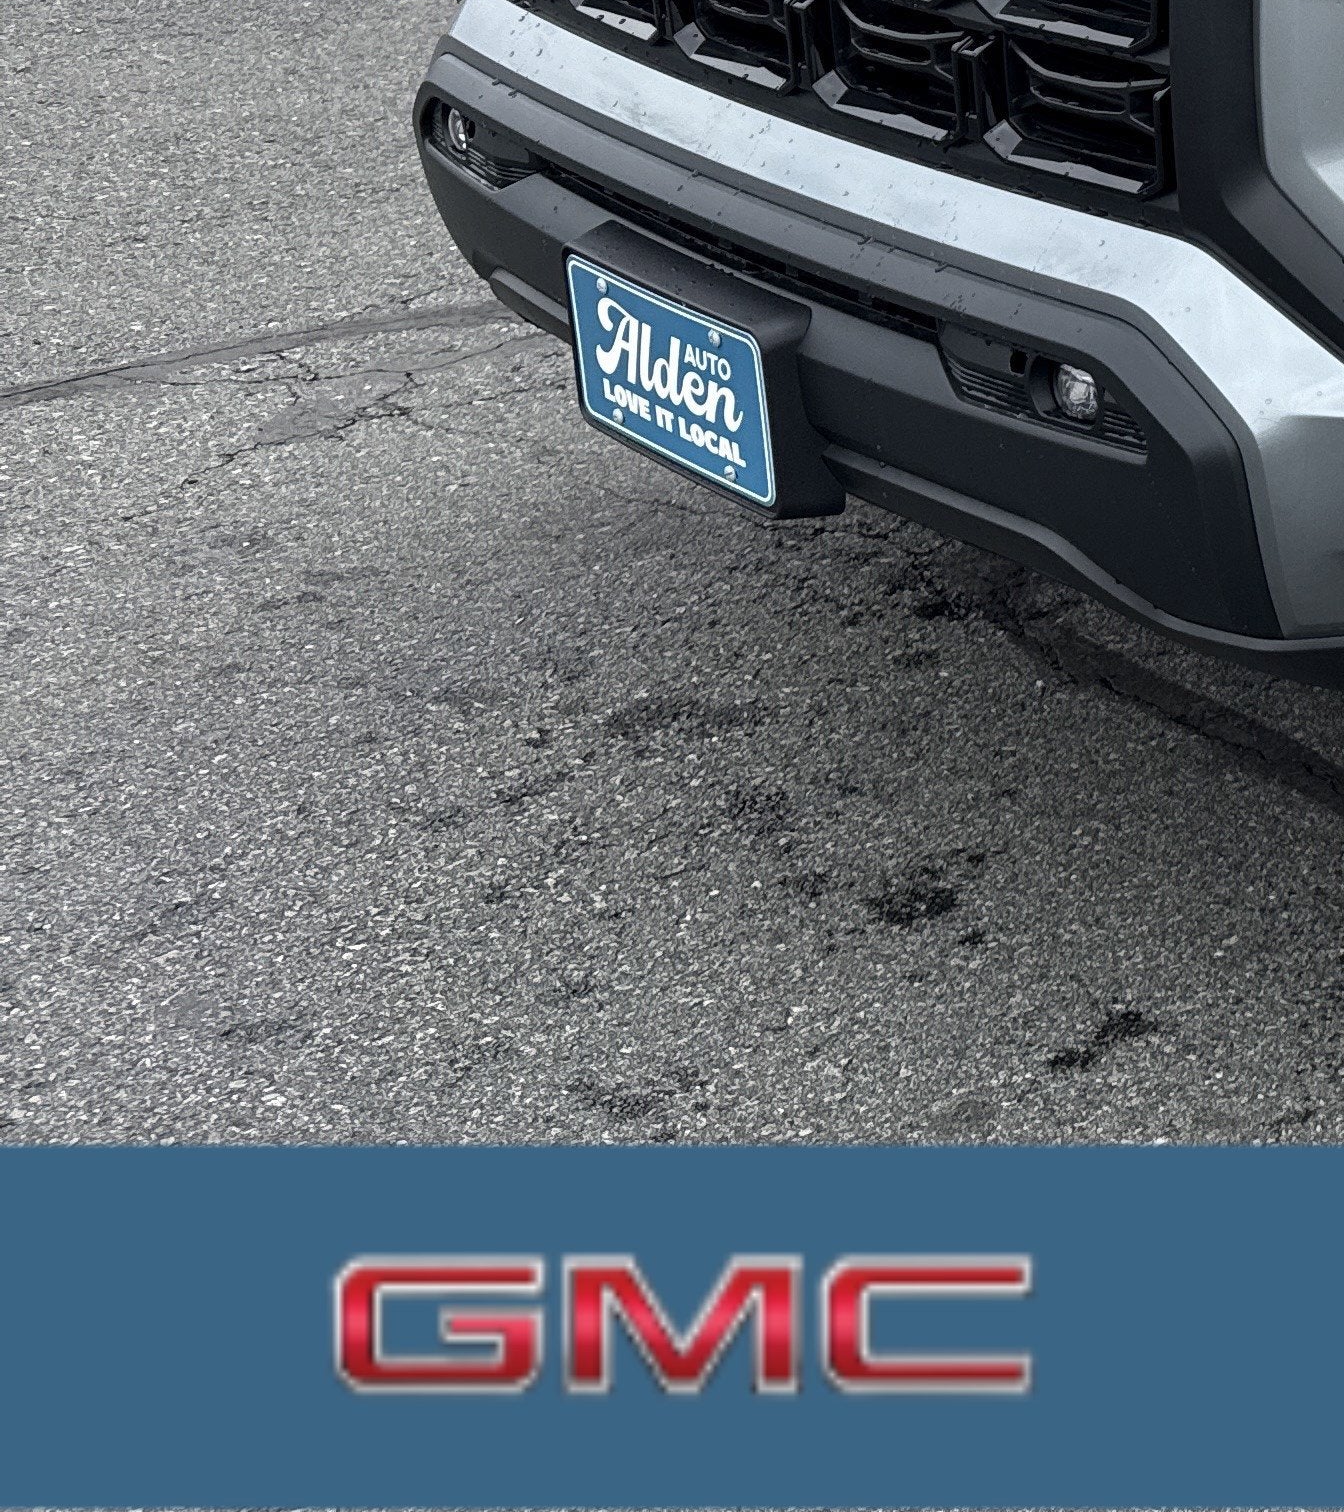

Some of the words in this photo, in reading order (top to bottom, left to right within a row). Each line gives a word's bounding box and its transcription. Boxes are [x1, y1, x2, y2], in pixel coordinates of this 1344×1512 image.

[595, 296, 744, 433] Alden
[683, 343, 732, 381] AUTO
[602, 377, 652, 422] LOVE
[655, 403, 675, 434] IT
[677, 416, 748, 469] LOCAL
